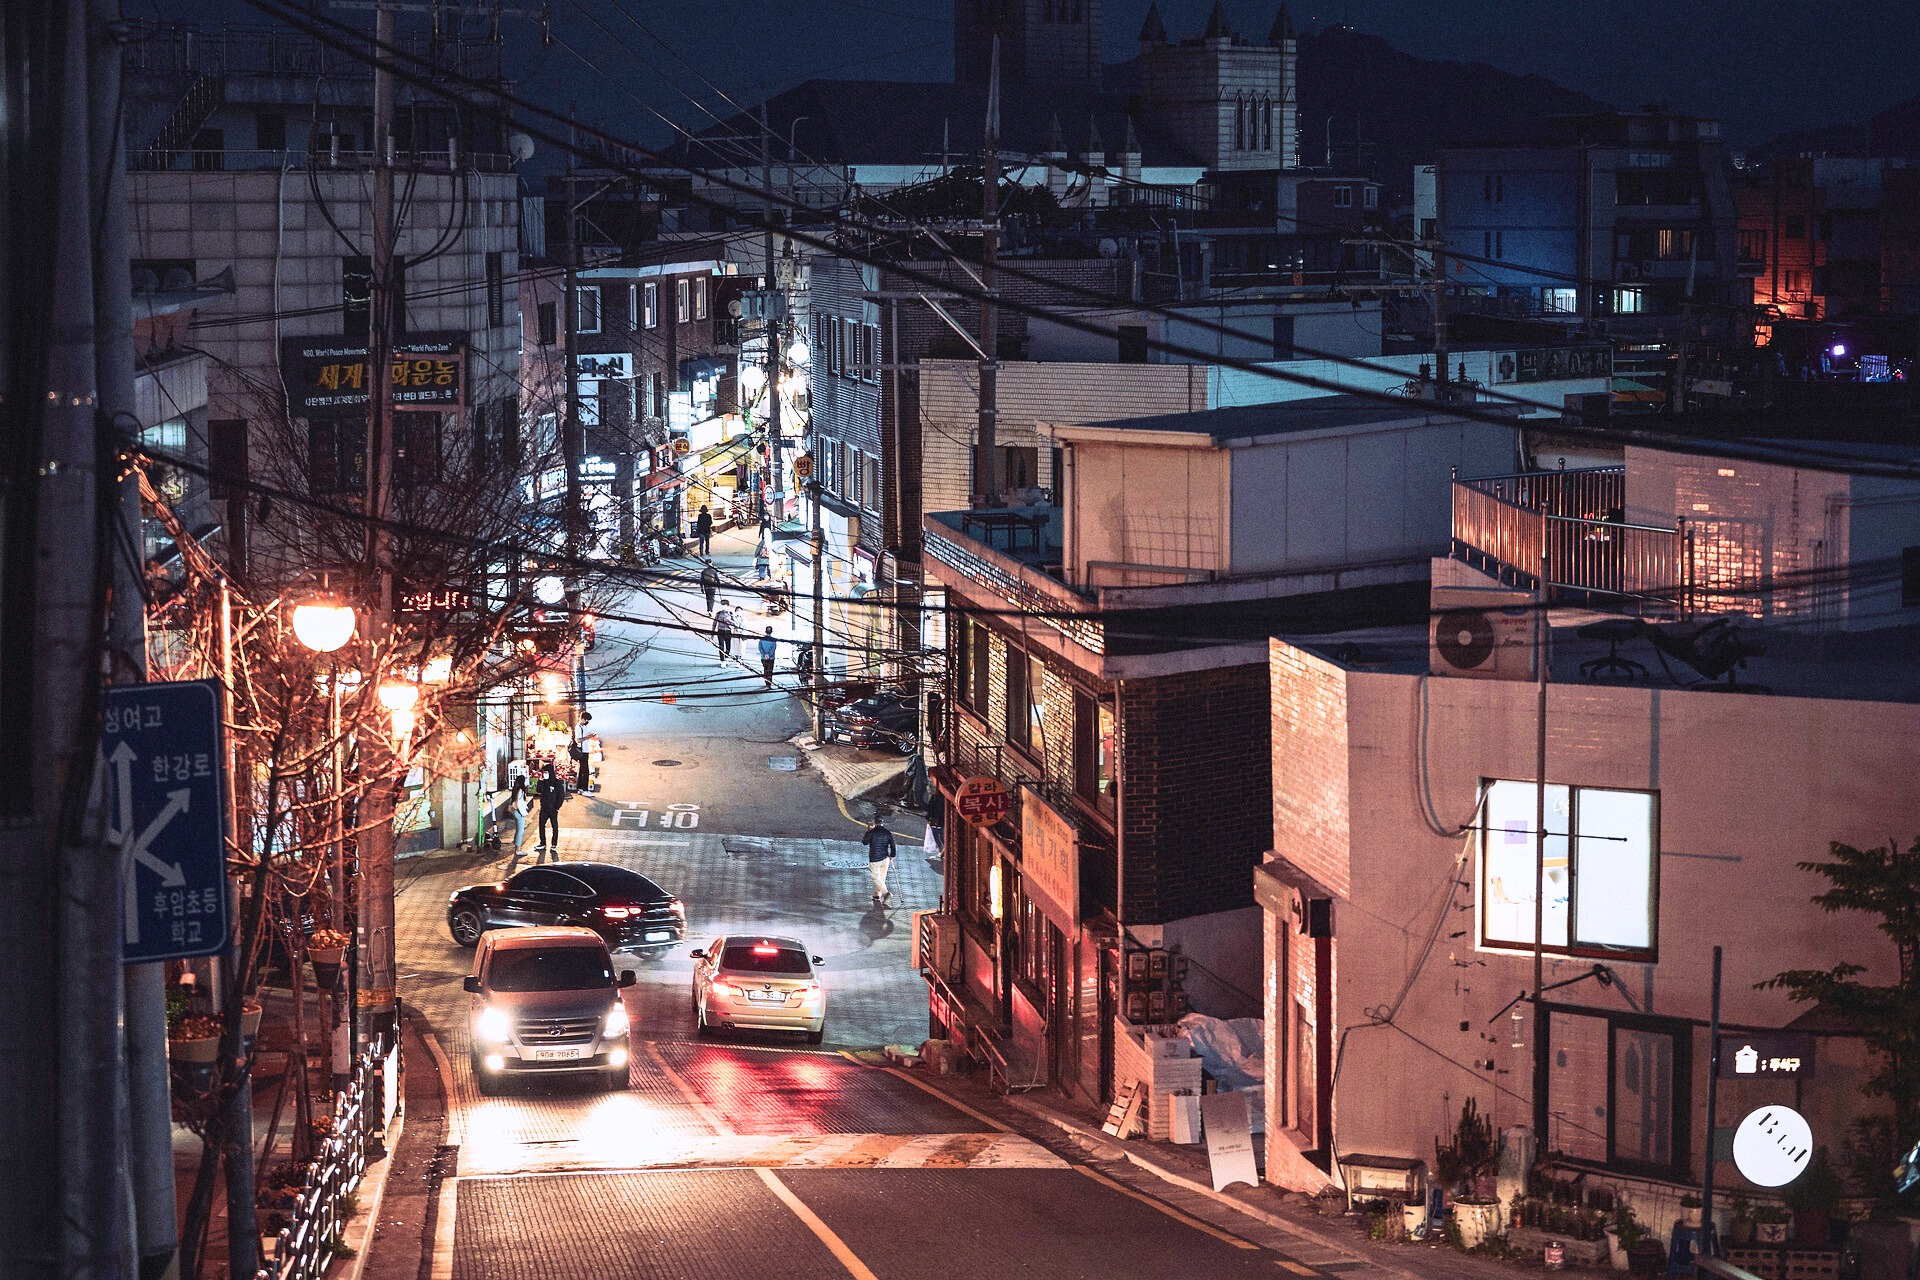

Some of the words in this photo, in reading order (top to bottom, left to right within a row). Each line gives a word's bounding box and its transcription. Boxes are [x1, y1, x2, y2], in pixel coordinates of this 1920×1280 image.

[315, 348, 330, 356] World
[330, 347, 344, 356] Peace
[316, 359, 455, 391] 세계화운동
[796, 459, 811, 476] 빵
[152, 753, 212, 783] 한강로
[963, 794, 1004, 812] 복사
[153, 887, 217, 918] 후암초등
[171, 919, 203, 947] 학교
